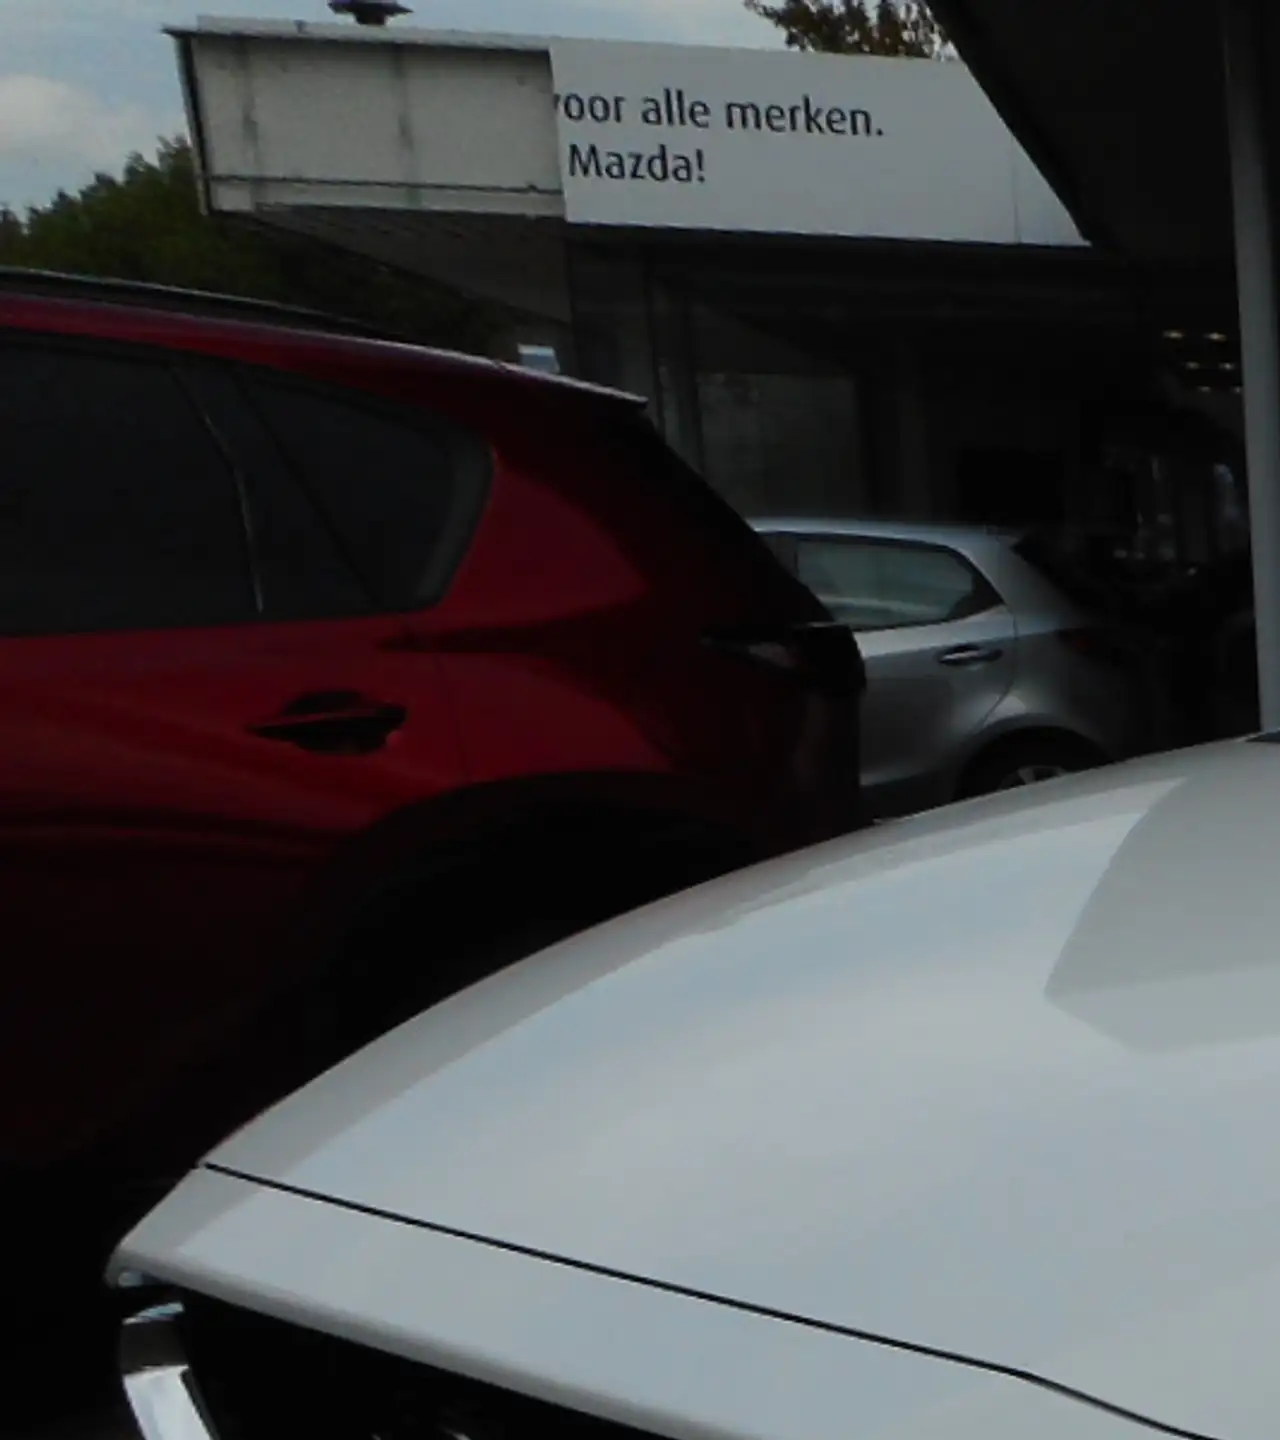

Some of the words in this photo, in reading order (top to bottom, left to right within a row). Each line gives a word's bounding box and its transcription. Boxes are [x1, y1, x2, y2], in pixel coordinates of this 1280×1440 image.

[641, 88, 711, 128] alle
[725, 95, 885, 137] merken.
[568, 143, 706, 184] Mazda!
